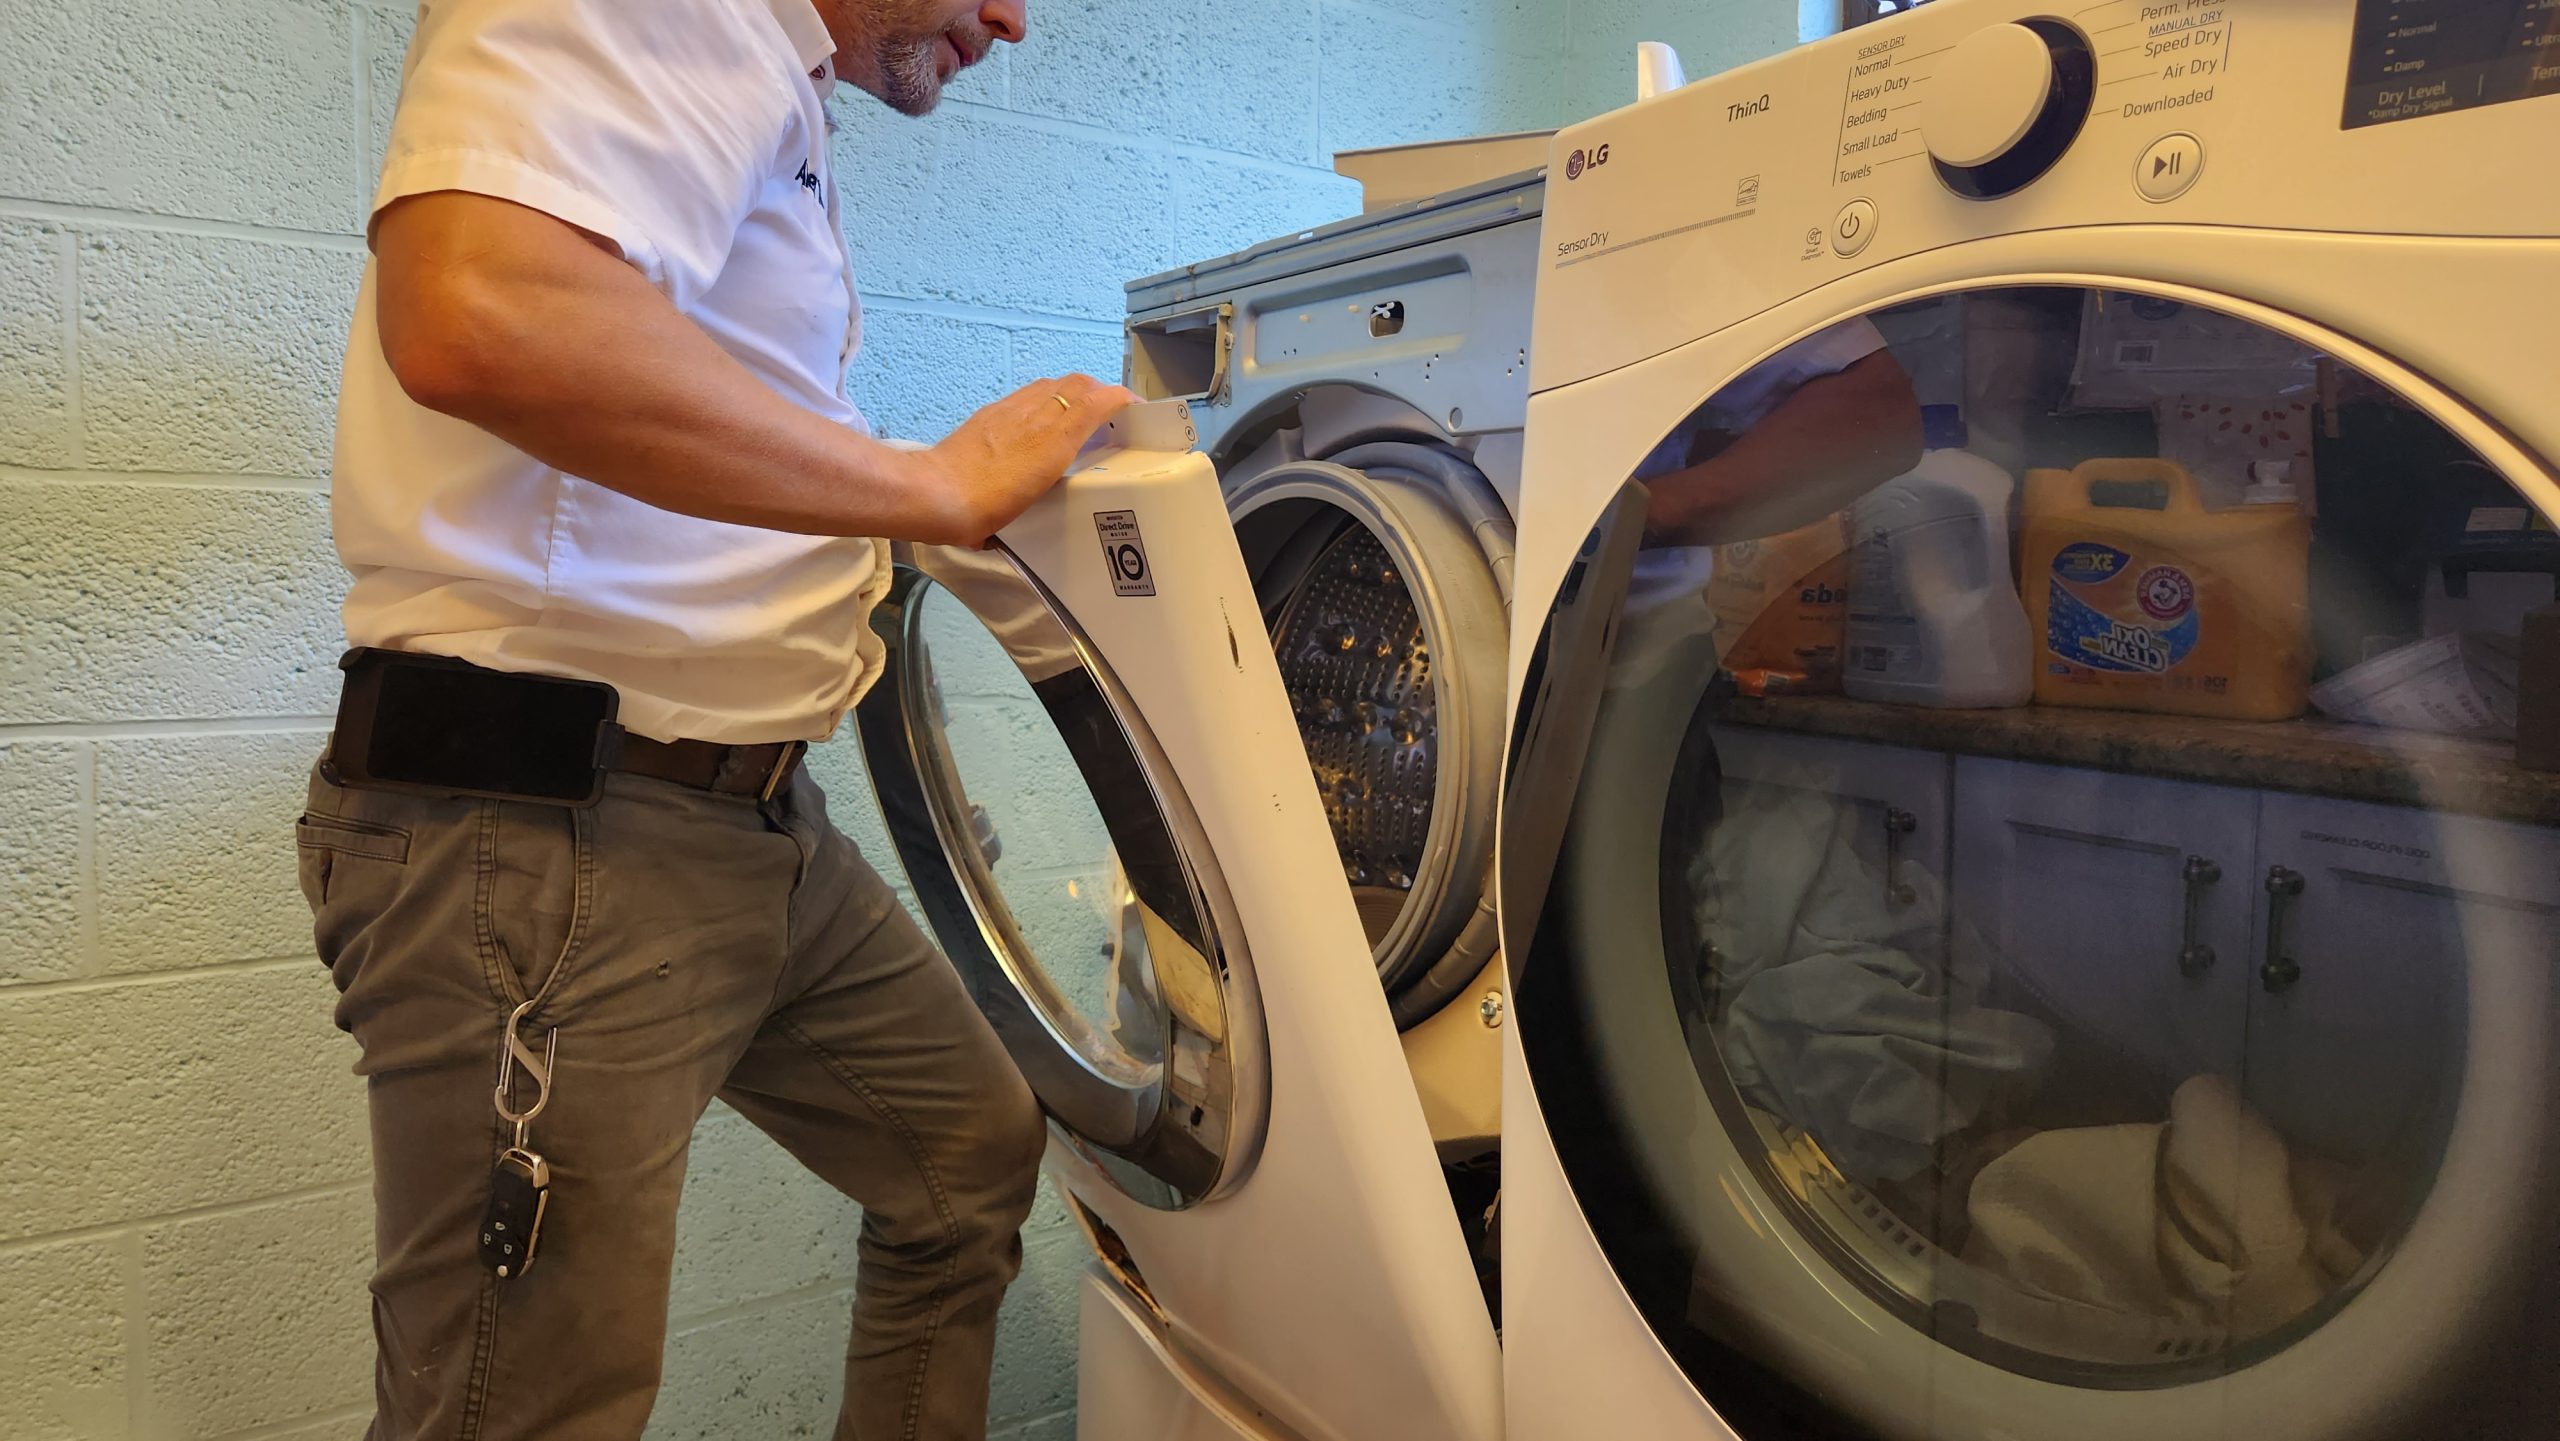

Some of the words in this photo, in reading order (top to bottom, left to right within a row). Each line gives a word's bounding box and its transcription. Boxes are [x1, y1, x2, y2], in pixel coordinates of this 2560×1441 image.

[2140, 3, 2181, 22] Perm.
[2187, 0, 2226, 10] Pre
[2148, 16, 2196, 36] MANUAL
[2200, 9, 2224, 24] DRY
[2398, 20, 2438, 38] Normal
[1857, 40, 1888, 58] SENSOR
[1889, 34, 1907, 48] DRY
[2144, 32, 2190, 58] Speed
[2194, 29, 2222, 46] Dry
[1854, 54, 1892, 78] Normal
[2162, 63, 2186, 81] Air
[2190, 59, 2218, 75] Dry
[2394, 58, 2425, 73] Damp
[2531, 66, 2560, 81] Tem
[1850, 84, 1882, 103] Heavy
[1884, 76, 1910, 93] Duty
[2378, 90, 2404, 106] Dry
[2408, 80, 2446, 100] Level
[1727, 94, 1770, 122] ThinQ
[2122, 85, 2214, 119] Downloaded
[1846, 108, 1887, 129] Bedding
[1842, 136, 1870, 156] Small
[1872, 128, 1899, 147] Load
[1586, 143, 1610, 170] LG
[1839, 164, 1872, 184] Towels
[1099, 522, 1118, 531] Direct
[1118, 521, 1135, 530] Drive
[1107, 543, 1144, 581] 10
